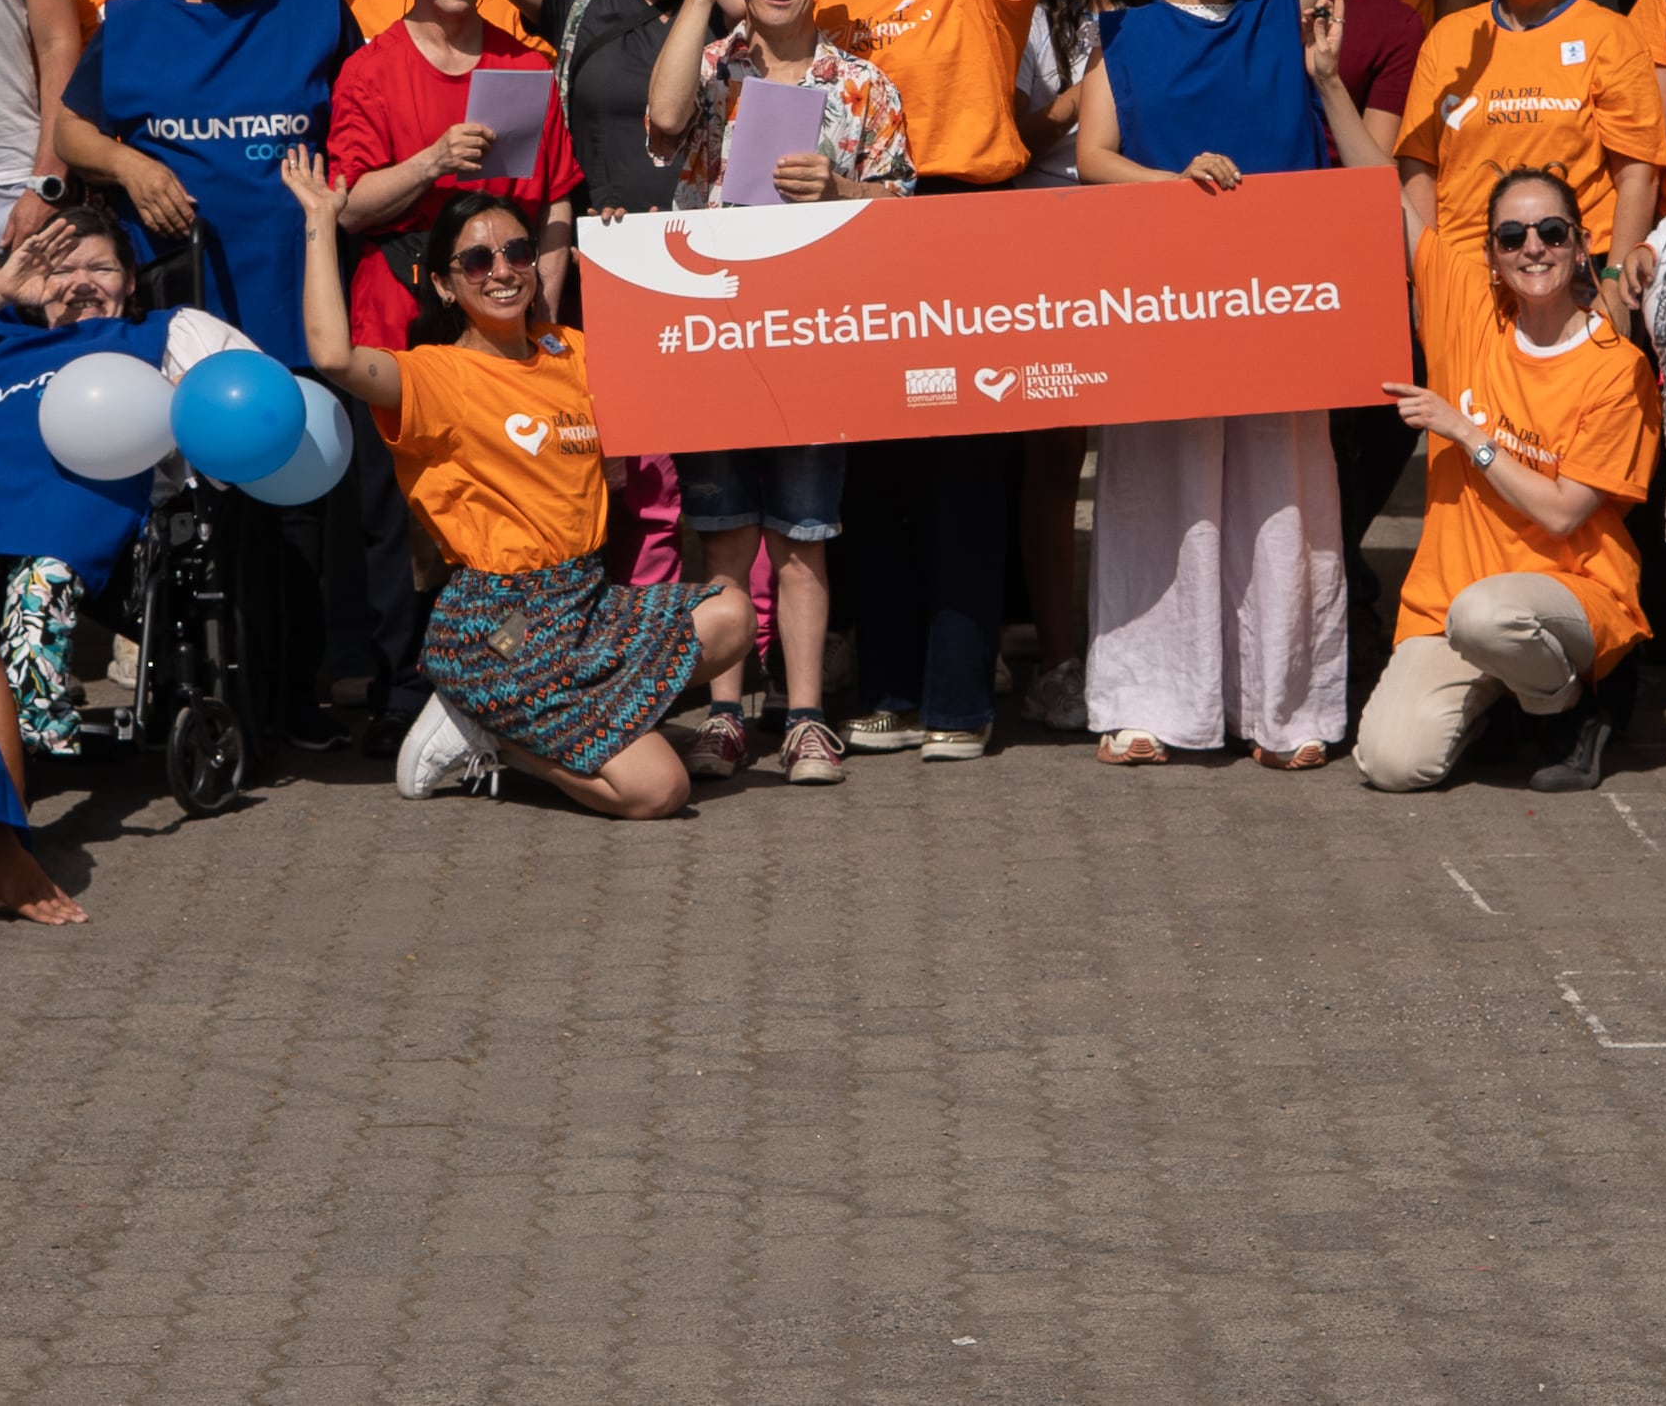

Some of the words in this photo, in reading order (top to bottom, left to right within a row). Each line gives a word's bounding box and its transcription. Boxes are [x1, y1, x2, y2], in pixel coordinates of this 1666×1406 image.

[1490, 87, 1517, 99] DÍA
[1519, 87, 1546, 97] DEL
[1488, 97, 1583, 113] PATRIMONIO
[1487, 110, 1544, 125] SOCIAL
[146, 115, 310, 141] VOLUNTARIO
[657, 277, 1341, 355] #DarEstáEnNuestraNaturaleza
[1025, 361, 1049, 376] DÍA
[1051, 362, 1077, 374] DEL
[1026, 371, 1108, 388] PATRIMONIO
[907, 392, 957, 403] comunidad
[1026, 385, 1079, 400] SOCIAL
